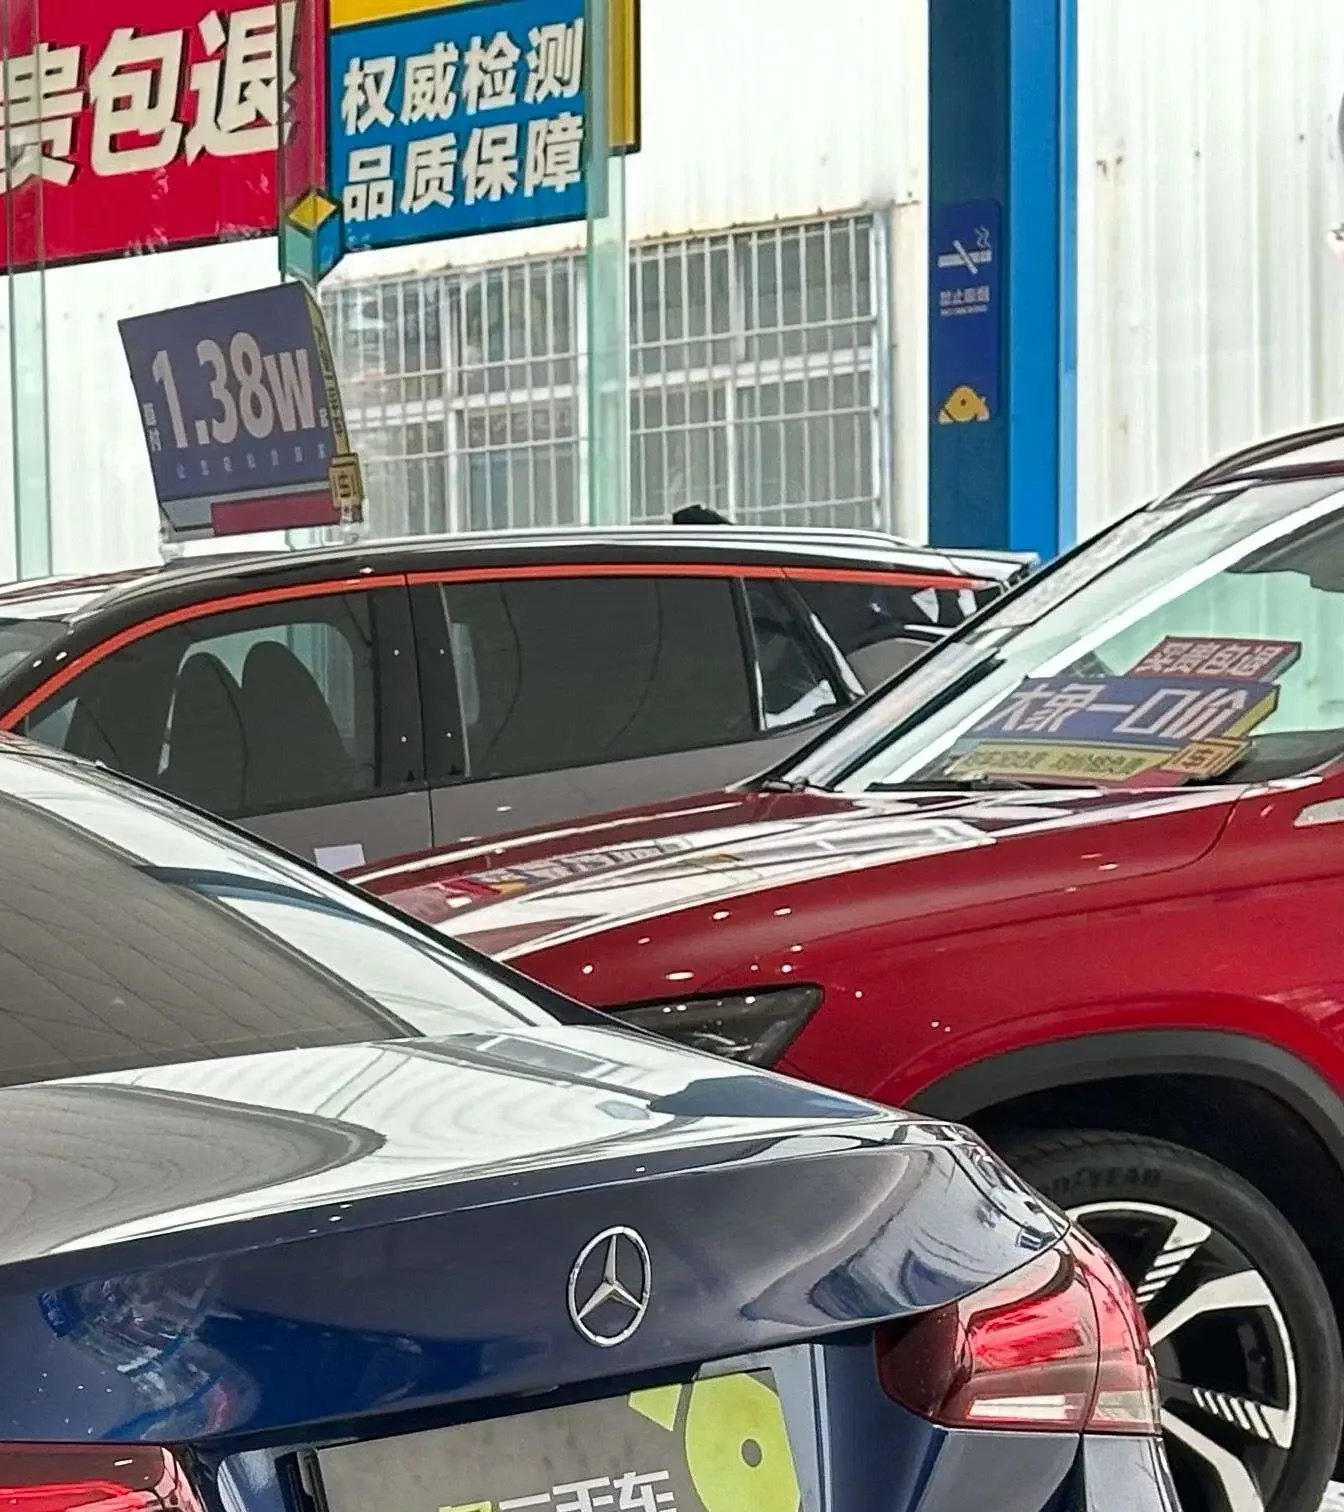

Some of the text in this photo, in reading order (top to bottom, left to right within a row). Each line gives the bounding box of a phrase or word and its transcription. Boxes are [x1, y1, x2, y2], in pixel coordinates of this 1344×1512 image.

[343, 17, 584, 136] 权威检测
[343, 112, 584, 222] 品质保障
[973, 682, 1250, 742] 大象一口价
